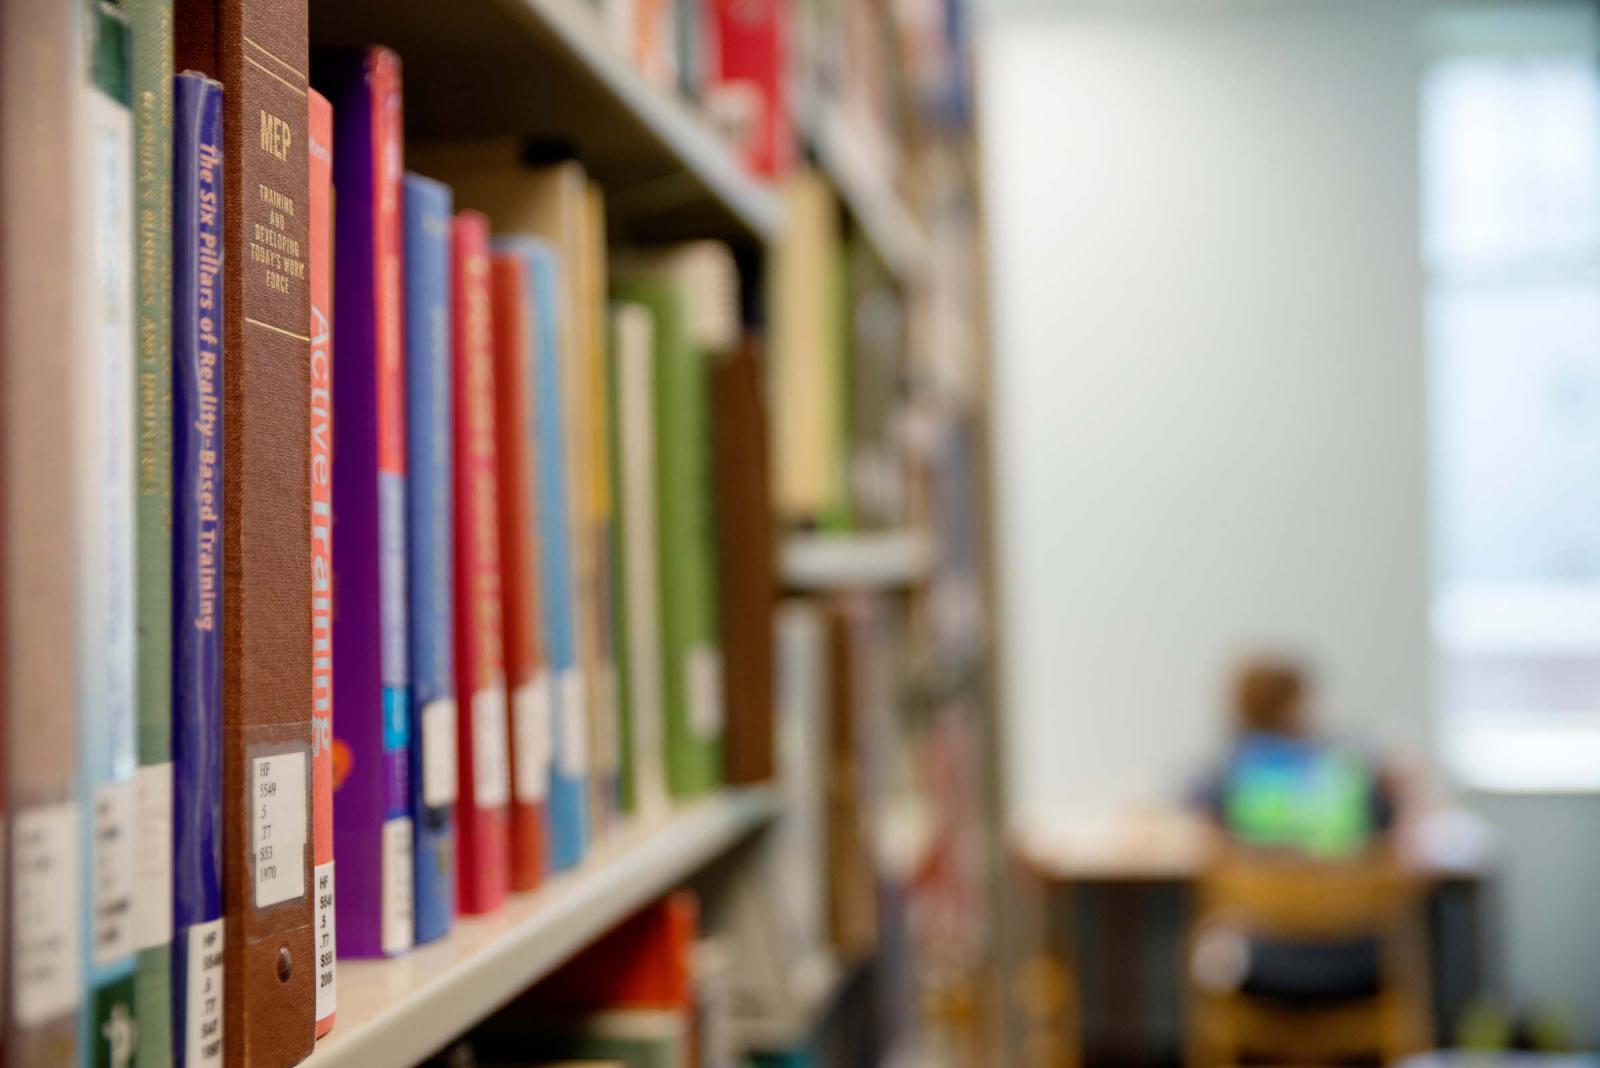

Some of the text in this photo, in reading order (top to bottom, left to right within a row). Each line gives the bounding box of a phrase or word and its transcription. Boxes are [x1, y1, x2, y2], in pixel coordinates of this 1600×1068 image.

[194, 143, 220, 632] The Six Pillars of Reality-Based Training
[259, 762, 271, 777] HF
[259, 782, 277, 799] 5549
[260, 865, 277, 883] 1970
